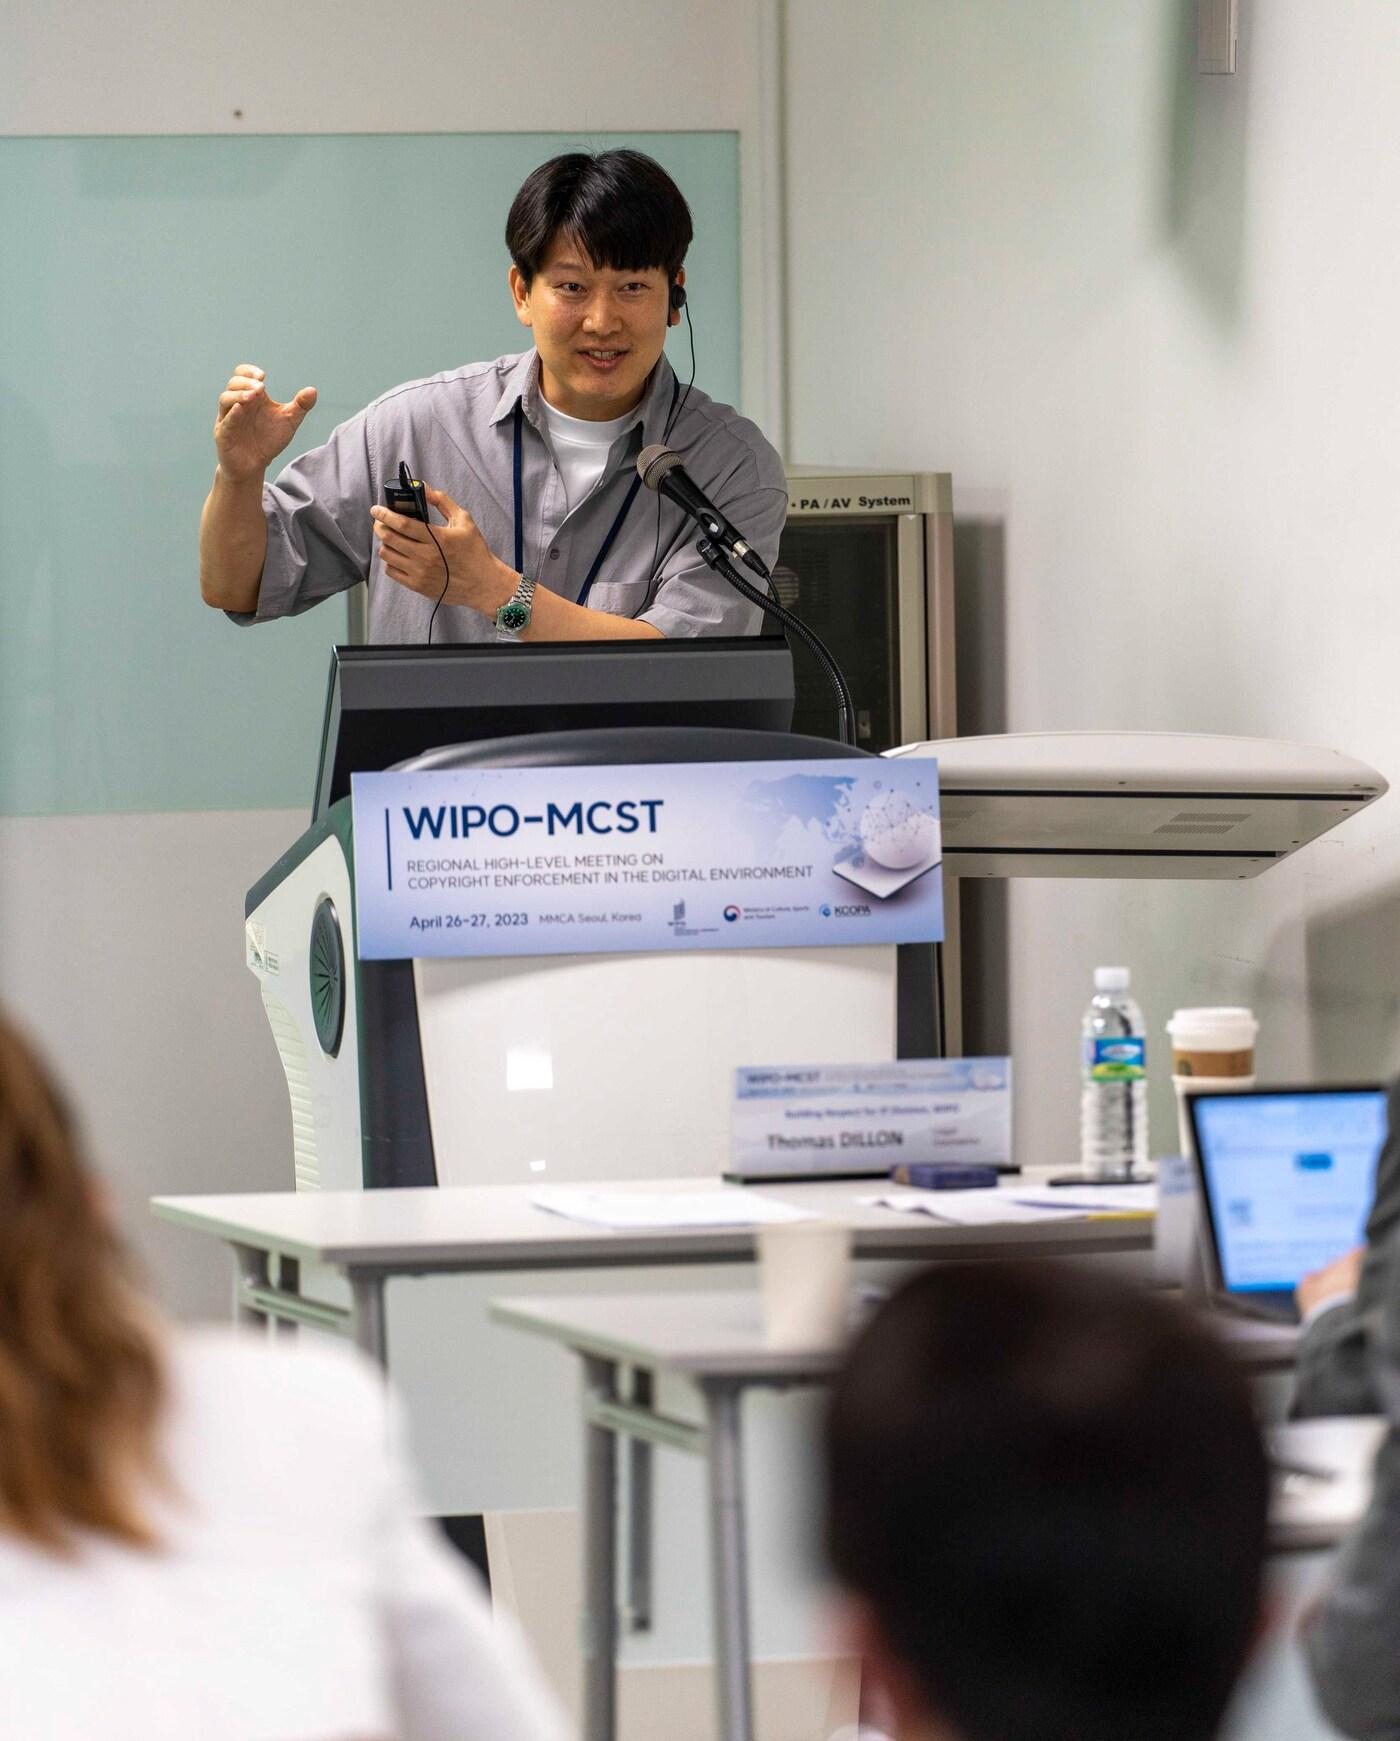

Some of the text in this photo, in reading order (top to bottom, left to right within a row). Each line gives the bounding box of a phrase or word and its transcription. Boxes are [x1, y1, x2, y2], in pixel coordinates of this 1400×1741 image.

[858, 496, 911, 509] System
[402, 799, 665, 841] WIPO-MCST
[407, 853, 664, 873] REGIONAL HIGH-LEVEL MEETING ON
[407, 864, 814, 890] COPYRIGHT ENFORCEMENT IN THE DIGITAL ENVIRONMENT
[409, 915, 442, 932] April
[445, 914, 491, 929] 26-27,
[495, 912, 529, 927] 2023
[539, 913, 575, 925] MMCA
[611, 911, 642, 923] Korea
[767, 1131, 903, 1151] Thomas DILLON
